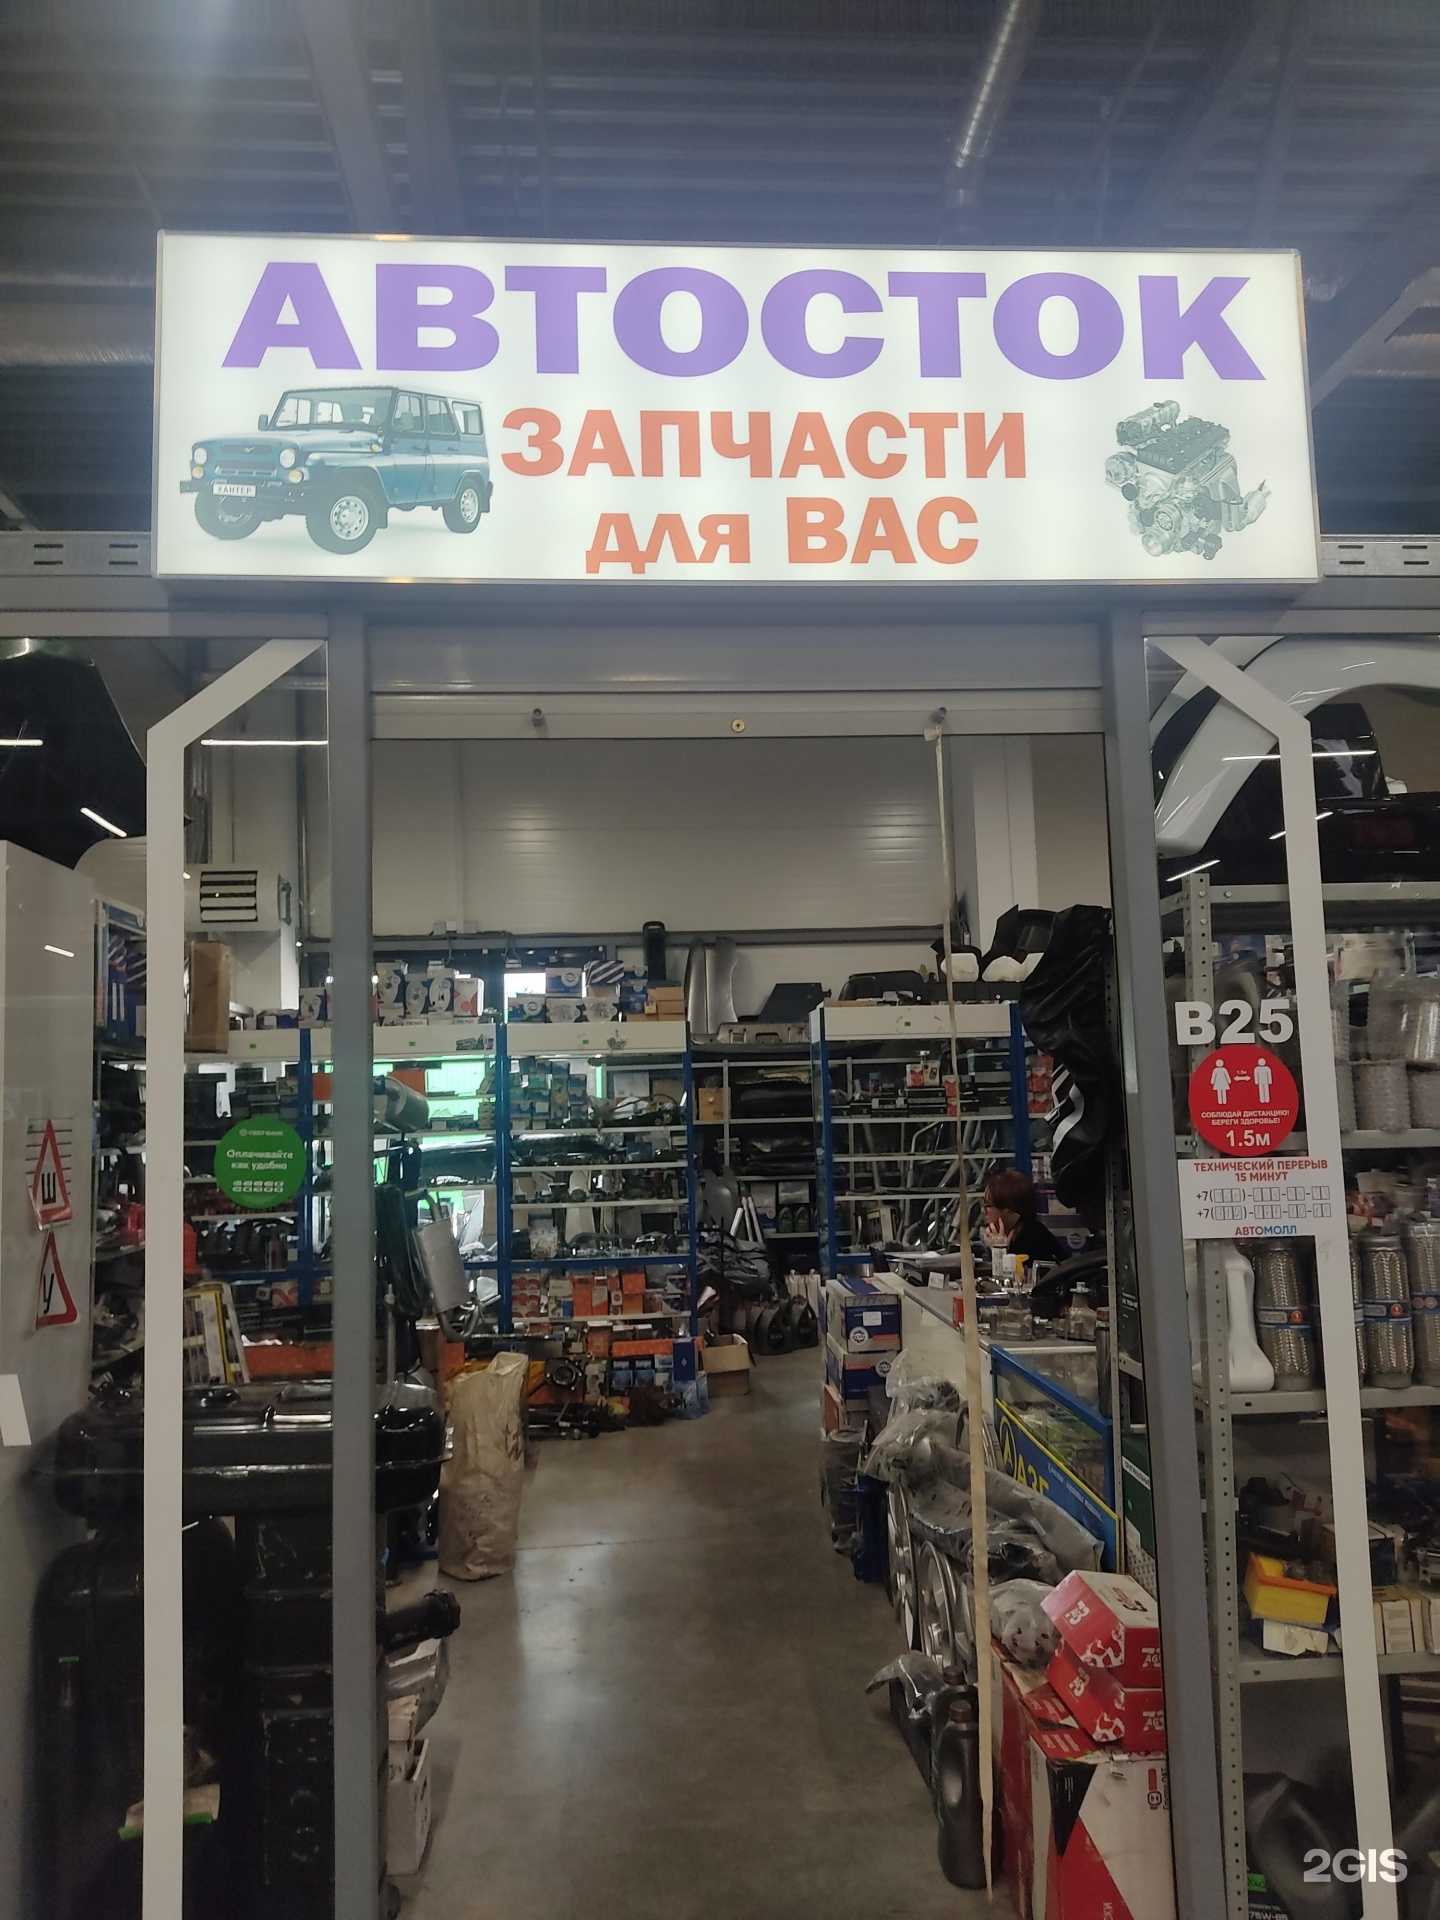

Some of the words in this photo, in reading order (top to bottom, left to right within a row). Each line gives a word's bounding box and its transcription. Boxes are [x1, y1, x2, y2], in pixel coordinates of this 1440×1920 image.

[222, 262, 1267, 380] АВТОСТОК
[501, 408, 1027, 478] ЗАПЧАСТИ
[786, 496, 979, 565] ВАС
[1211, 1118, 1239, 1126] БЕРЕГИ
[226, 1149, 294, 1159] Оплачивайте
[251, 1160, 288, 1171] удобно
[1194, 1159, 1275, 1172] ТЕХНИЧЕСКИЙ
[1277, 1160, 1328, 1170] ПЕРЕРЫВ
[1235, 1172, 1248, 1182] 15
[1250, 1171, 1289, 1181] МИНУТ
[41, 1172, 57, 1204] Ш
[1235, 1225, 1297, 1236] АВТОМОЛЛ
